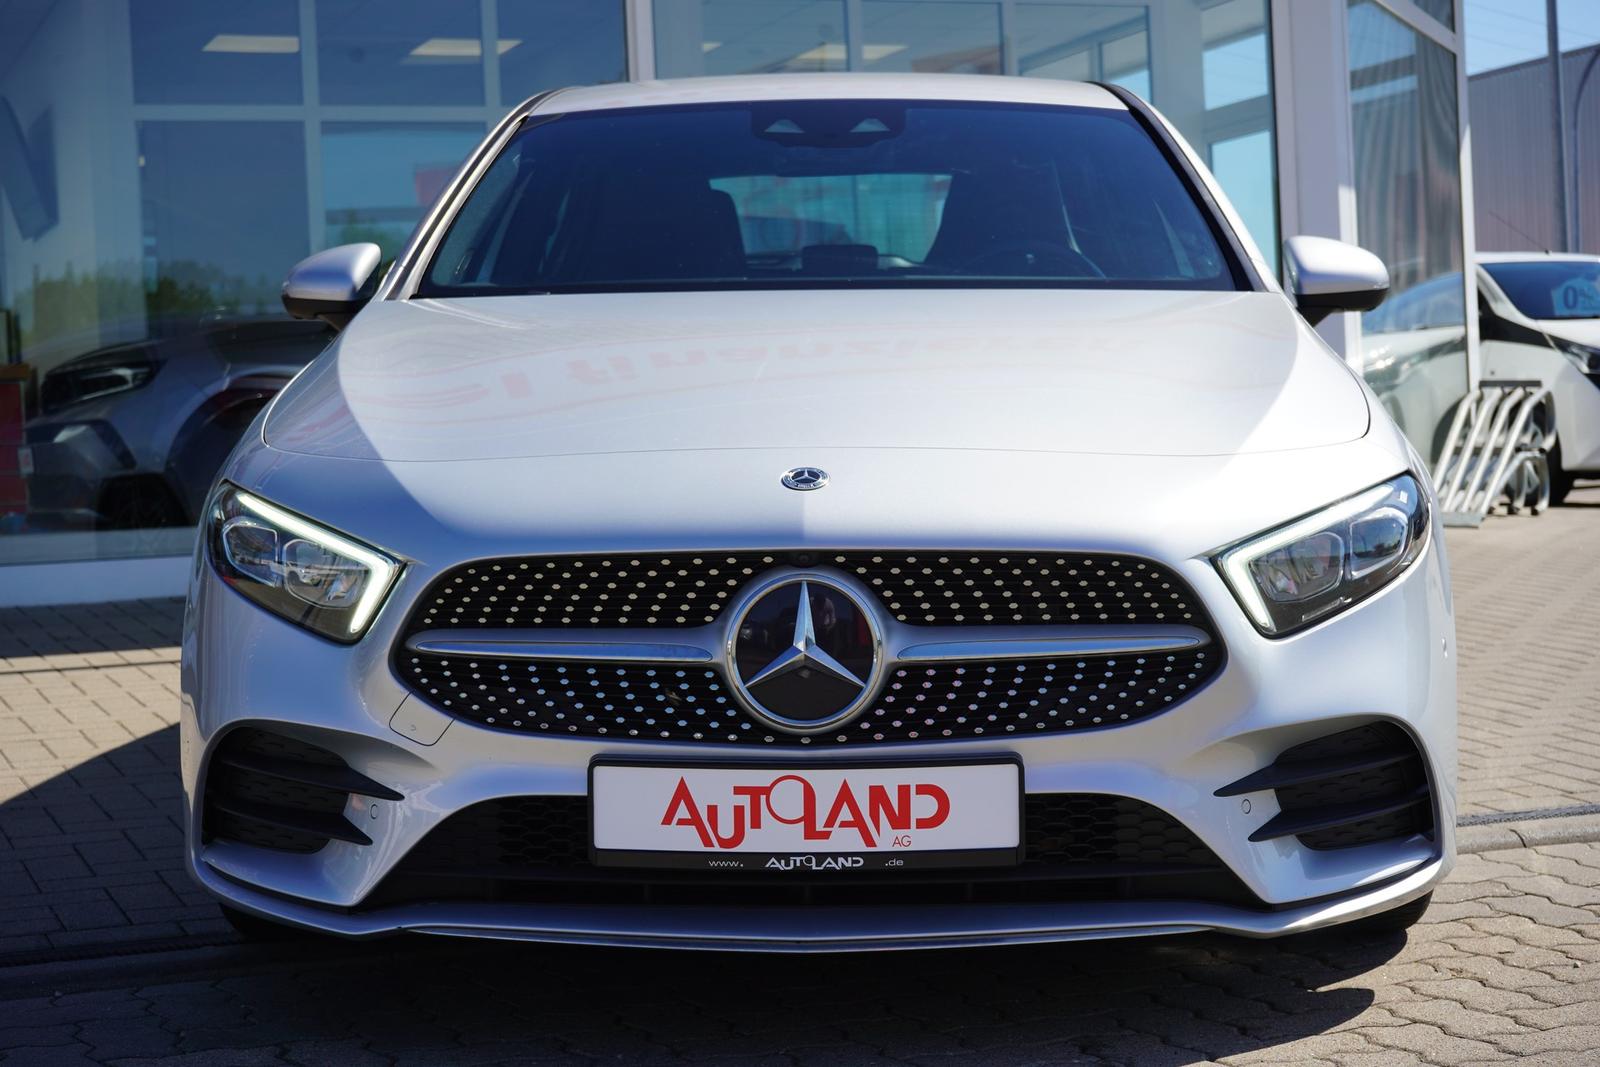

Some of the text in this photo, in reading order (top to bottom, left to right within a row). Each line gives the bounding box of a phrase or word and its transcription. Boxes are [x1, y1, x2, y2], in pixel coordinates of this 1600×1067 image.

[660, 774, 951, 849] AUTOLAND
[892, 835, 912, 848] AG
[708, 855, 904, 871] www. AUTOLAND .de
